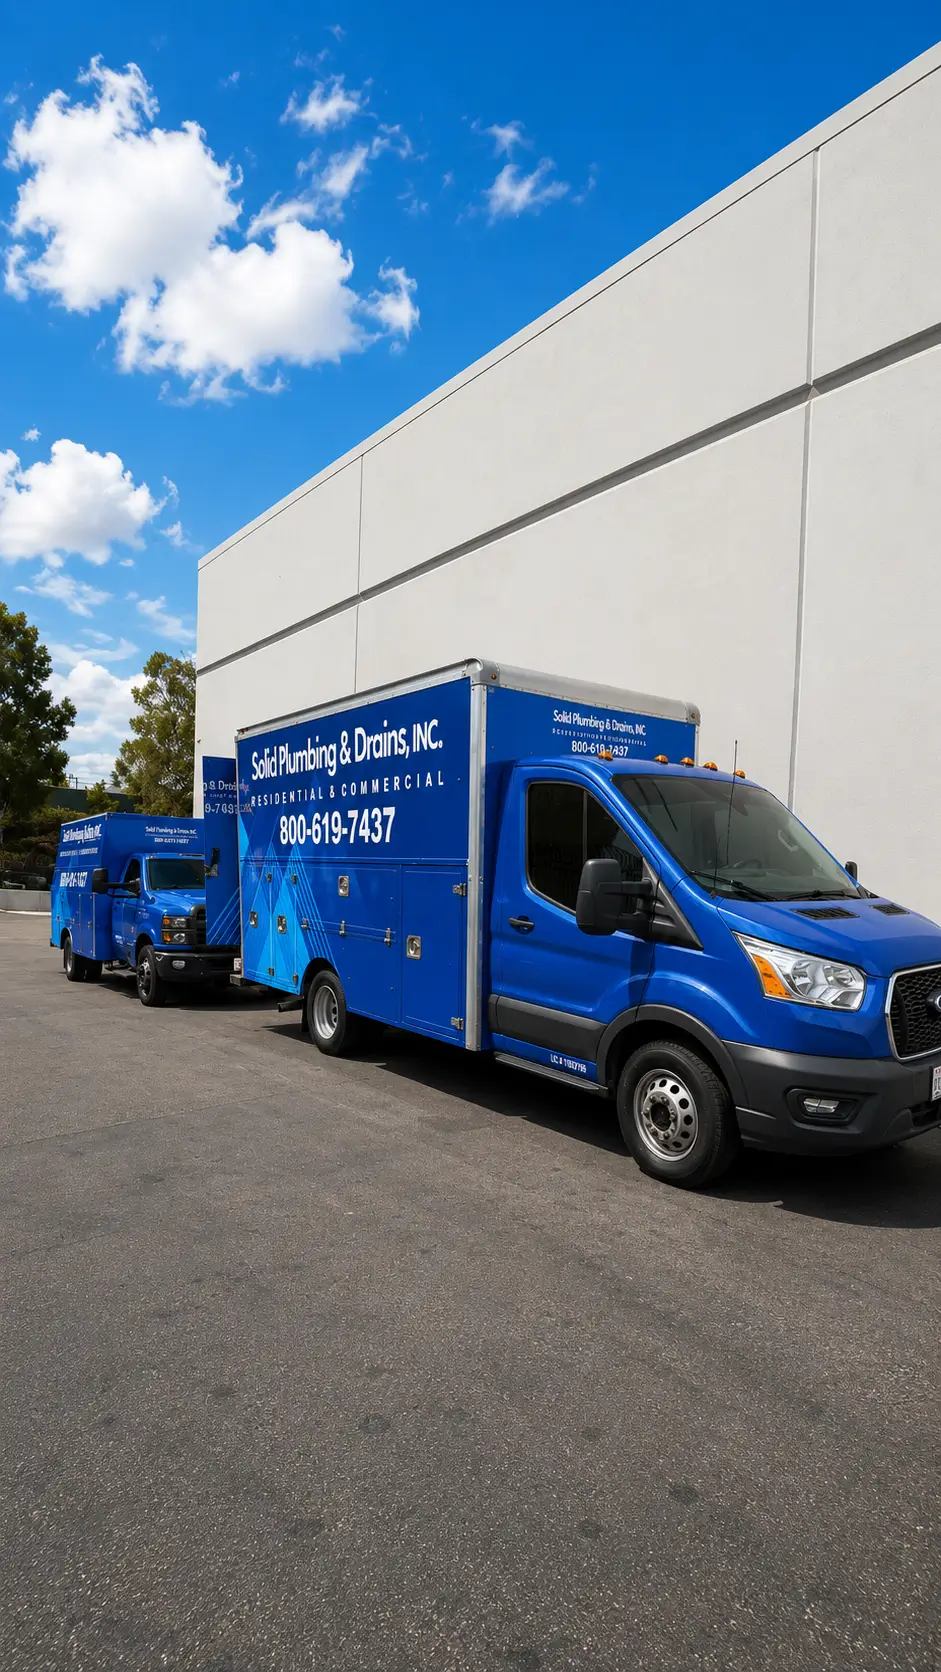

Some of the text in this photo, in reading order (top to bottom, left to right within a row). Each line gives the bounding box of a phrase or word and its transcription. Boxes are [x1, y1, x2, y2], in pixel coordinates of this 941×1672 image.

[251, 718, 443, 780] Solid Plumbing & Drains, INC.
[251, 786, 323, 807] RESIDENTIAL
[329, 785, 335, 799] &
[341, 770, 444, 797] COMMERCIAL
[279, 806, 396, 845] 800-619-7437
